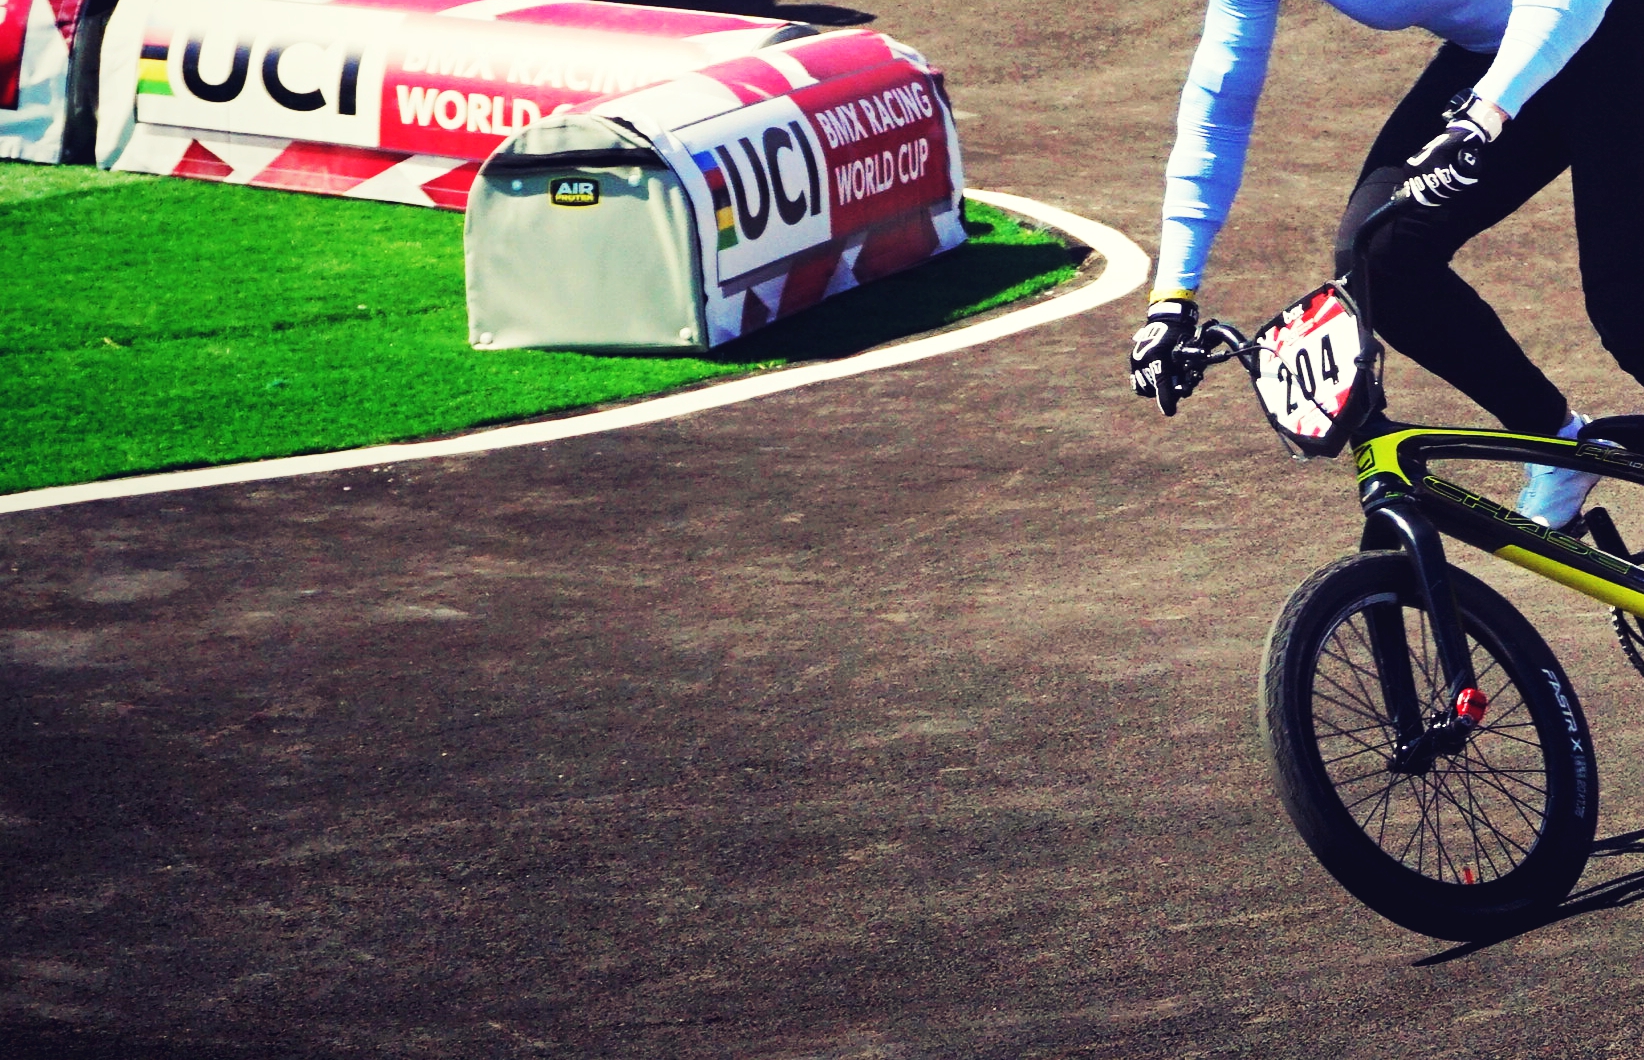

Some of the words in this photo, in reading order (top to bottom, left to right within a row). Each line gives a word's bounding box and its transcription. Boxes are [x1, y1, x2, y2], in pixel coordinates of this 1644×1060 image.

[180, 34, 361, 116] UCI
[396, 85, 542, 133] WORLD
[815, 104, 868, 148] BMX
[864, 82, 934, 137] RACING
[556, 182, 594, 194] AIR
[719, 119, 824, 240] UCI
[835, 154, 895, 207] WORLD
[897, 138, 929, 184] CUP
[1282, 303, 1305, 324] box
[1277, 333, 1340, 416] 204
[1422, 474, 1632, 575] CHASE
[1541, 667, 1578, 733] FASTR
[1570, 737, 1584, 753] X
